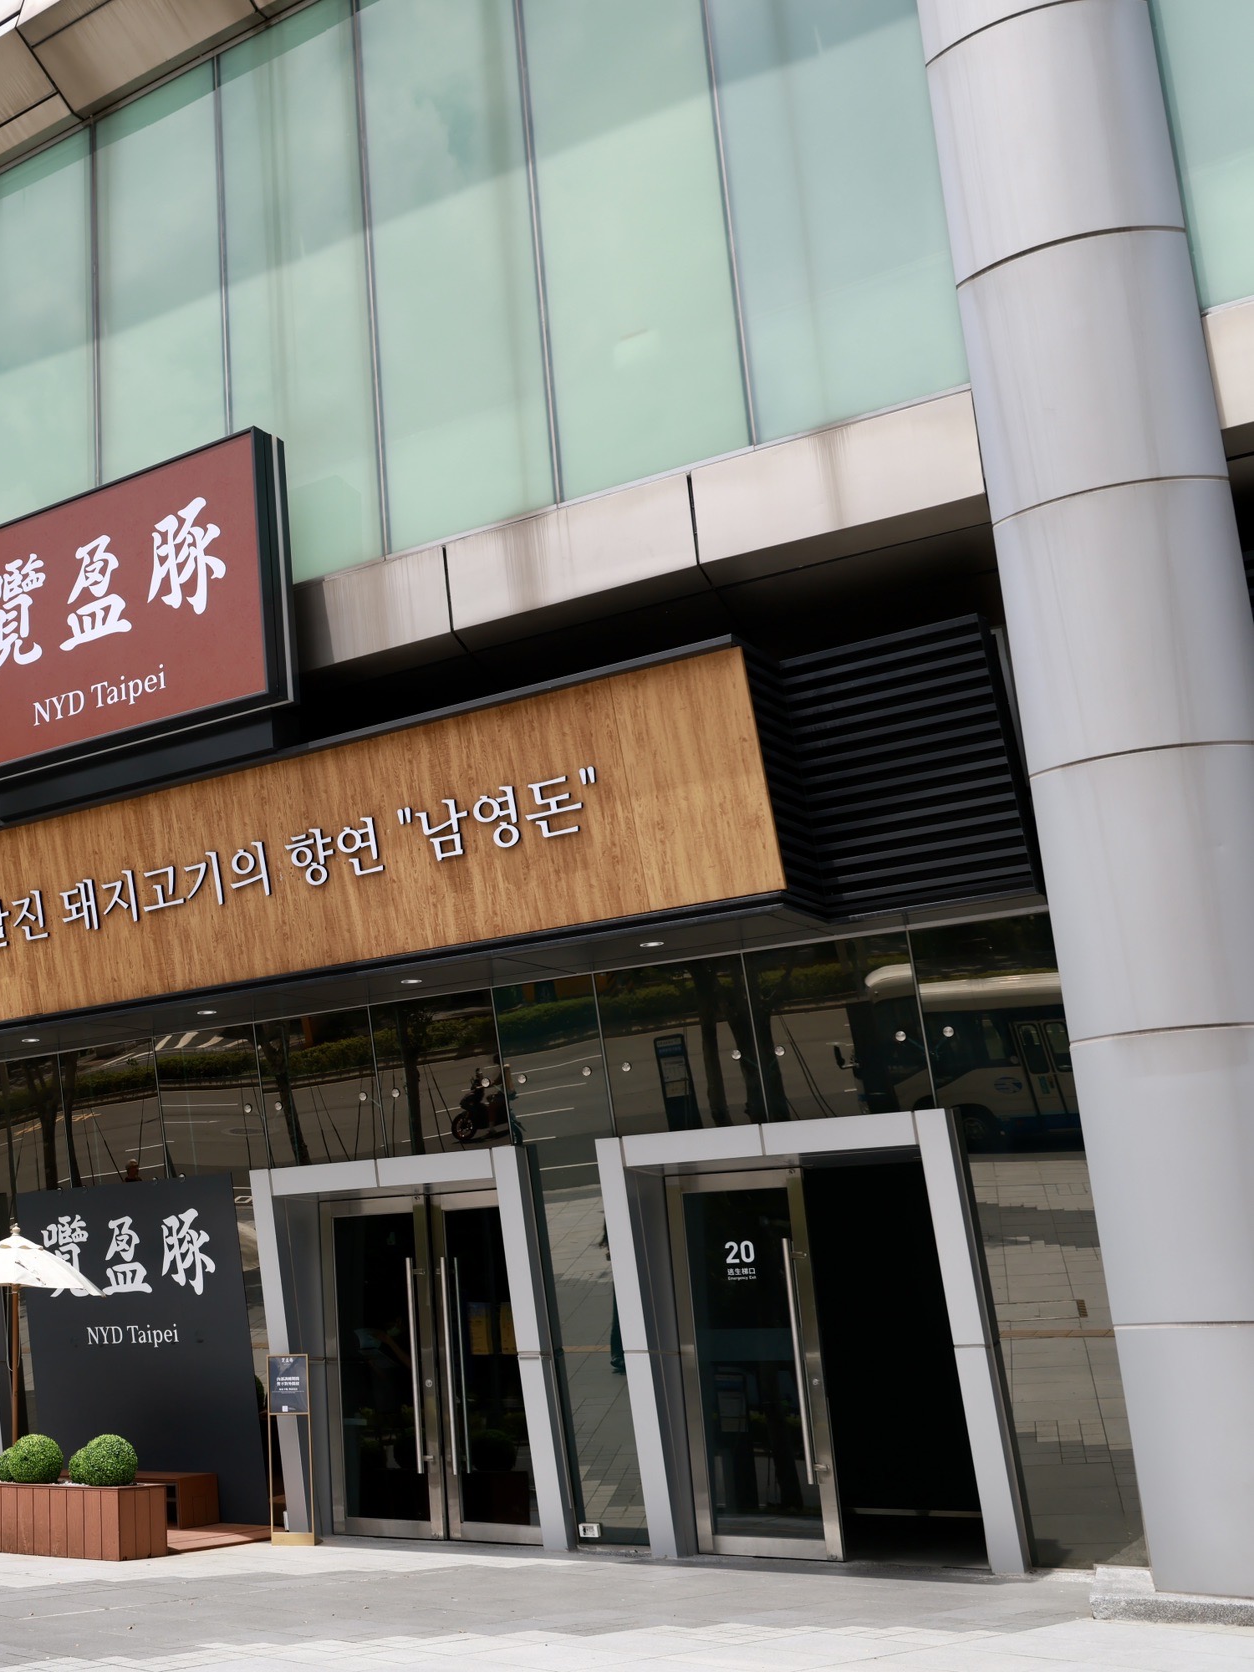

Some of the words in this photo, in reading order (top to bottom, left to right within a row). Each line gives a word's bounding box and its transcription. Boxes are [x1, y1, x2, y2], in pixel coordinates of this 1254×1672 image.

[32, 689, 85, 726] NYD
[90, 664, 167, 709] Taipei
[59, 841, 271, 931] 돼지고기의
[285, 816, 385, 886] 향연
[725, 1240, 755, 1264] 20
[86, 1326, 123, 1344] NYD
[126, 1323, 179, 1348] Taipei
